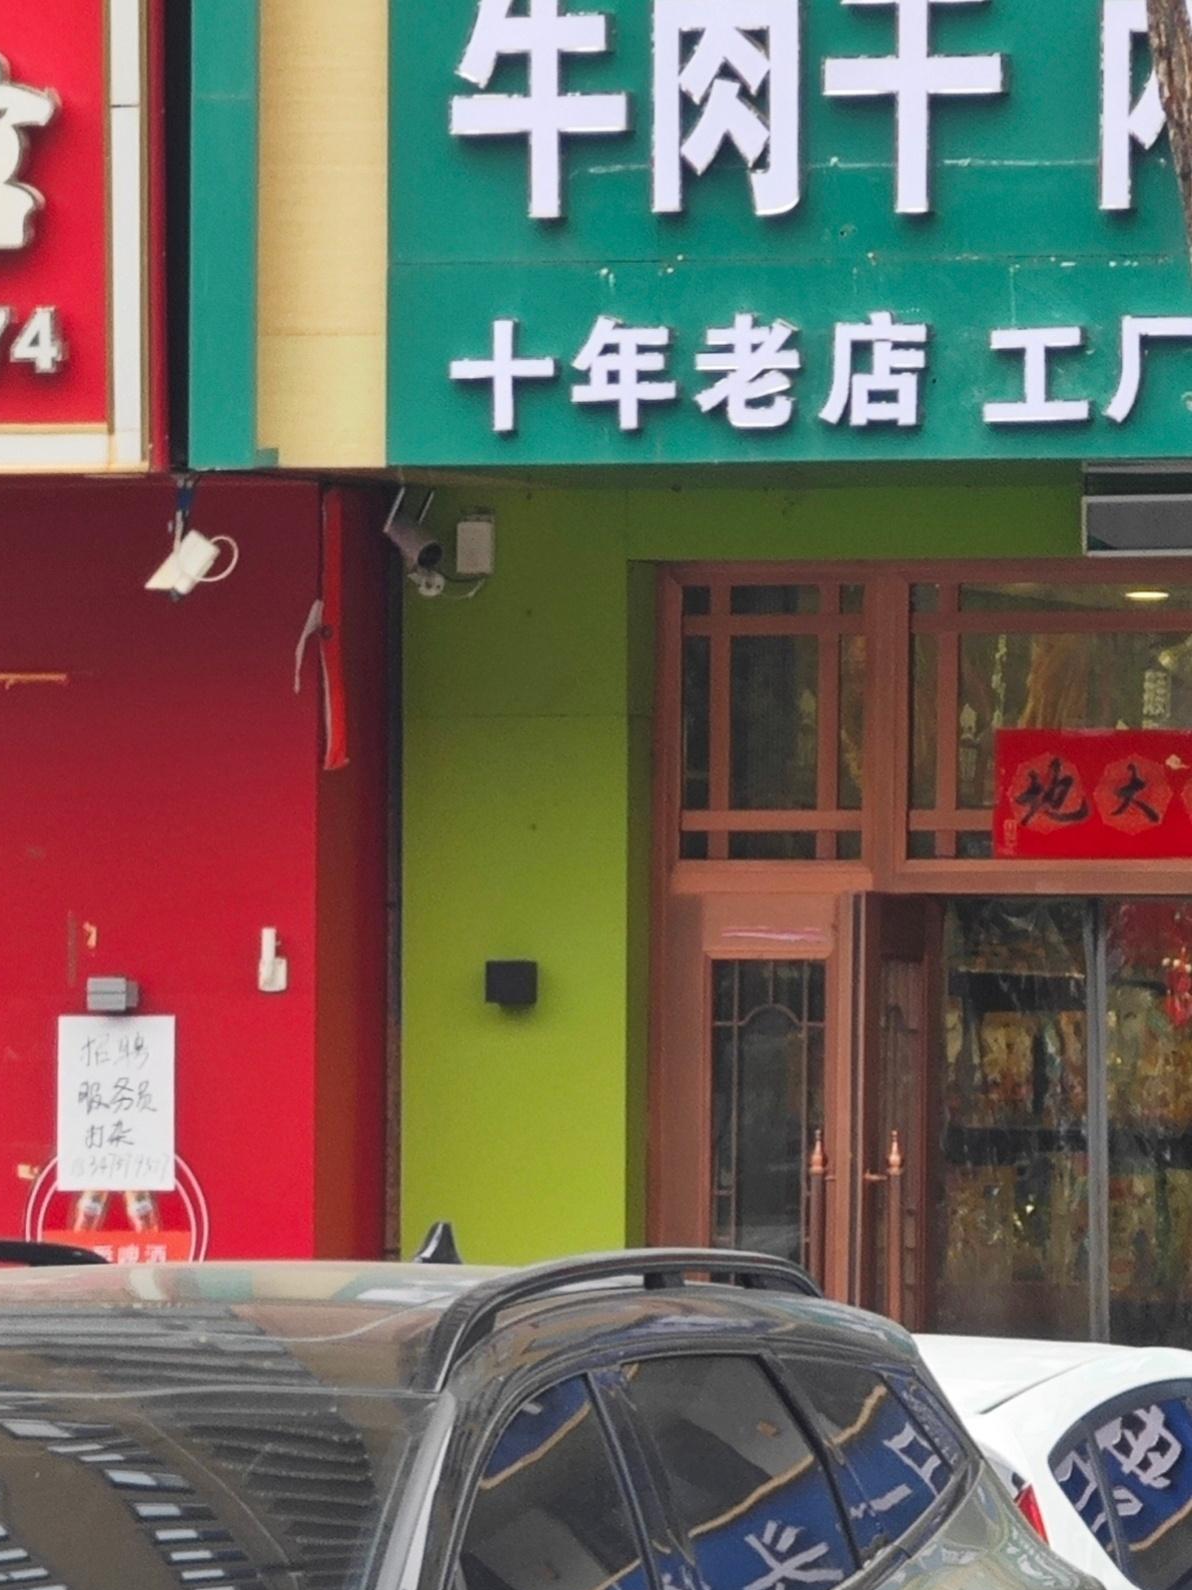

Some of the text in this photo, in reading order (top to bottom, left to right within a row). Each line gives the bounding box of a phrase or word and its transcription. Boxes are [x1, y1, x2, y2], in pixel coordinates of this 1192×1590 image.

[449, 310, 930, 432] 十年老店
[78, 1077, 157, 1115] 服务员
